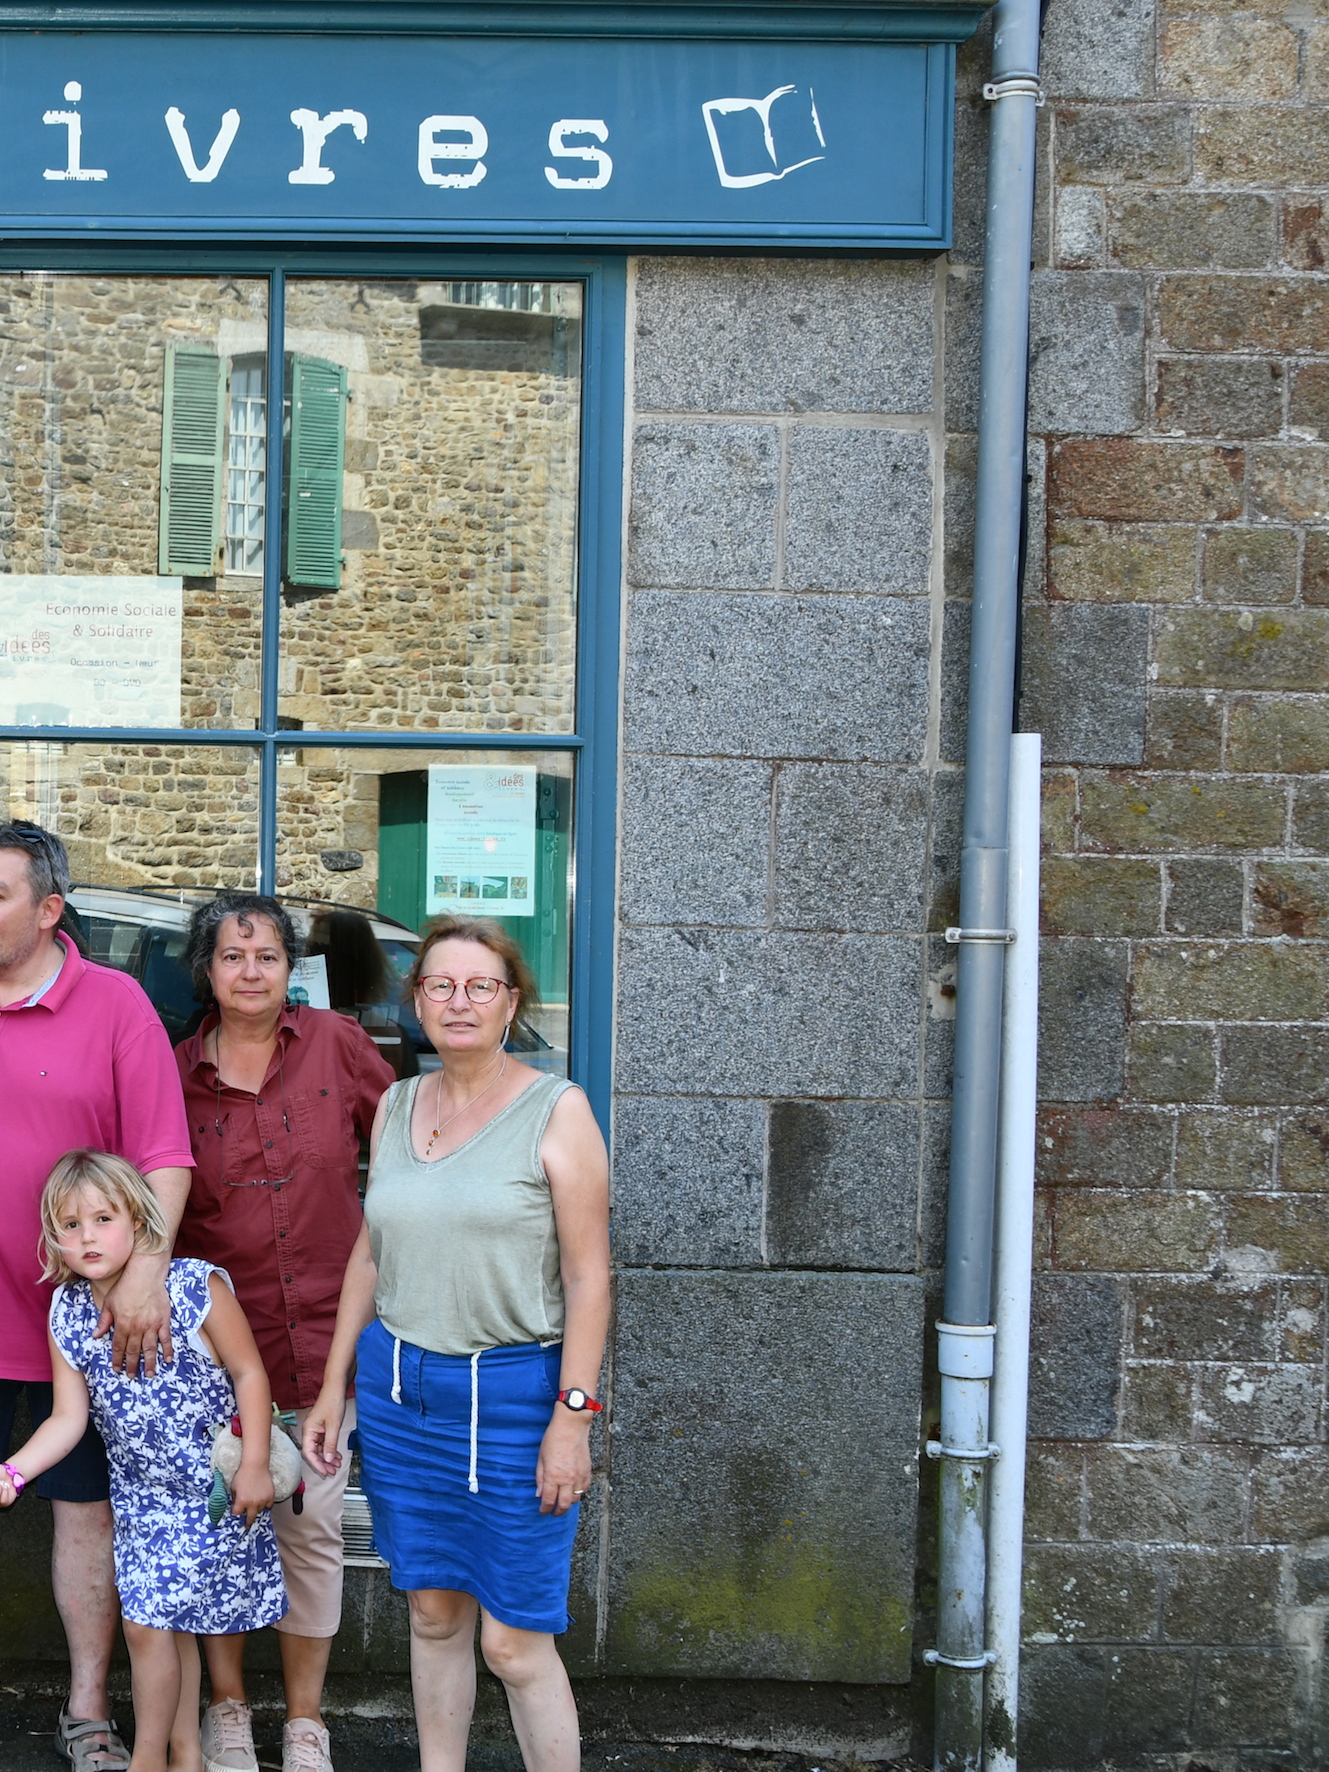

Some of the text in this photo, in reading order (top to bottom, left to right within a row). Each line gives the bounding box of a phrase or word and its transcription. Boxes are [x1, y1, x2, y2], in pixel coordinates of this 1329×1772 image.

[46, 603, 176, 617] Economie Sociale
[32, 628, 51, 640] des
[72, 624, 154, 638] & Solidaire
[4, 635, 51, 654] idées
[498, 776, 524, 787] idées
